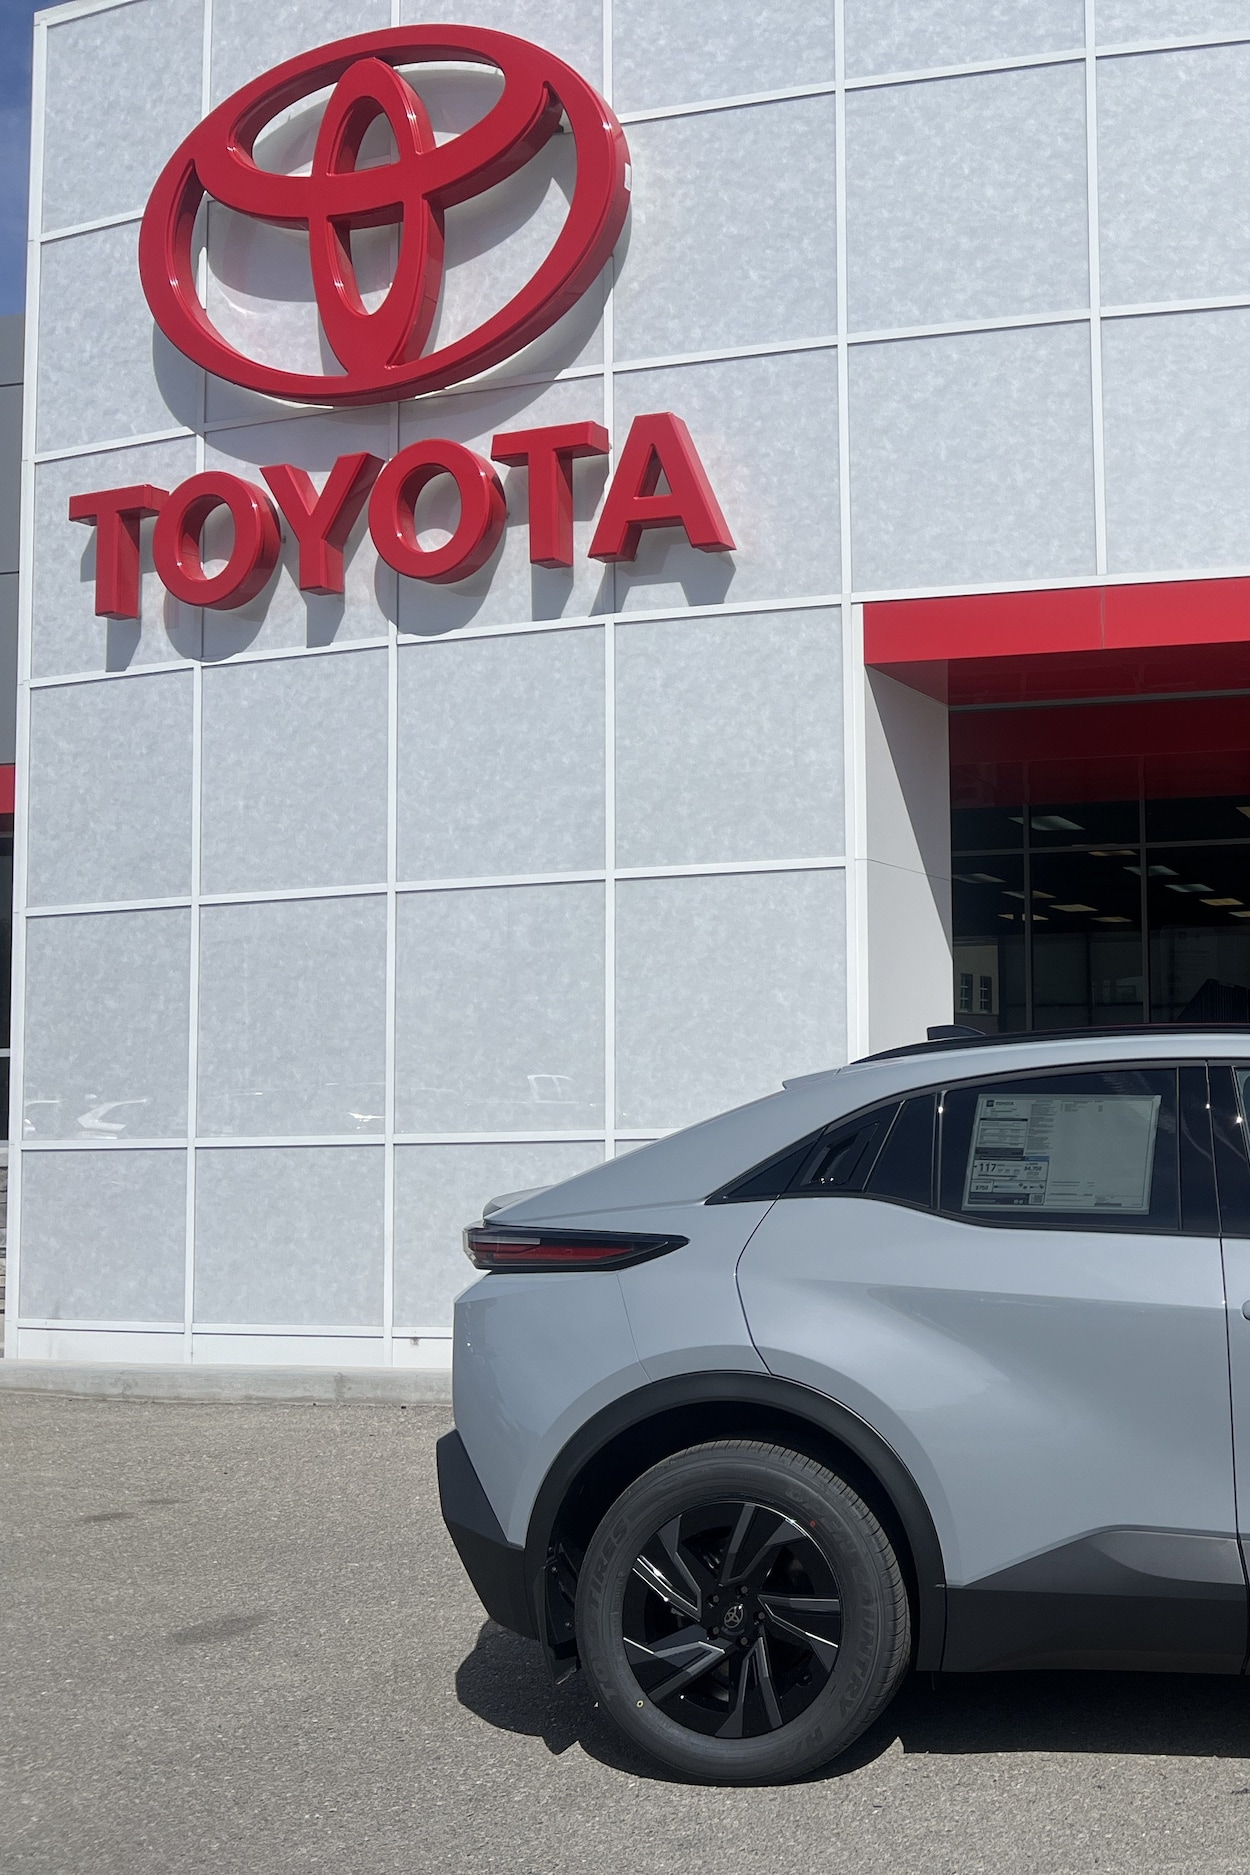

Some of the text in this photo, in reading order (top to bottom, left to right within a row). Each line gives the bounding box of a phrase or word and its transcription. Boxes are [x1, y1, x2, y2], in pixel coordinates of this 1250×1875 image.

[68, 412, 737, 620] TOYOTA
[979, 1163, 998, 1172] 117
[589, 1516, 628, 1612] TIRES
[784, 1487, 874, 1719] OPEN COUNTRY
